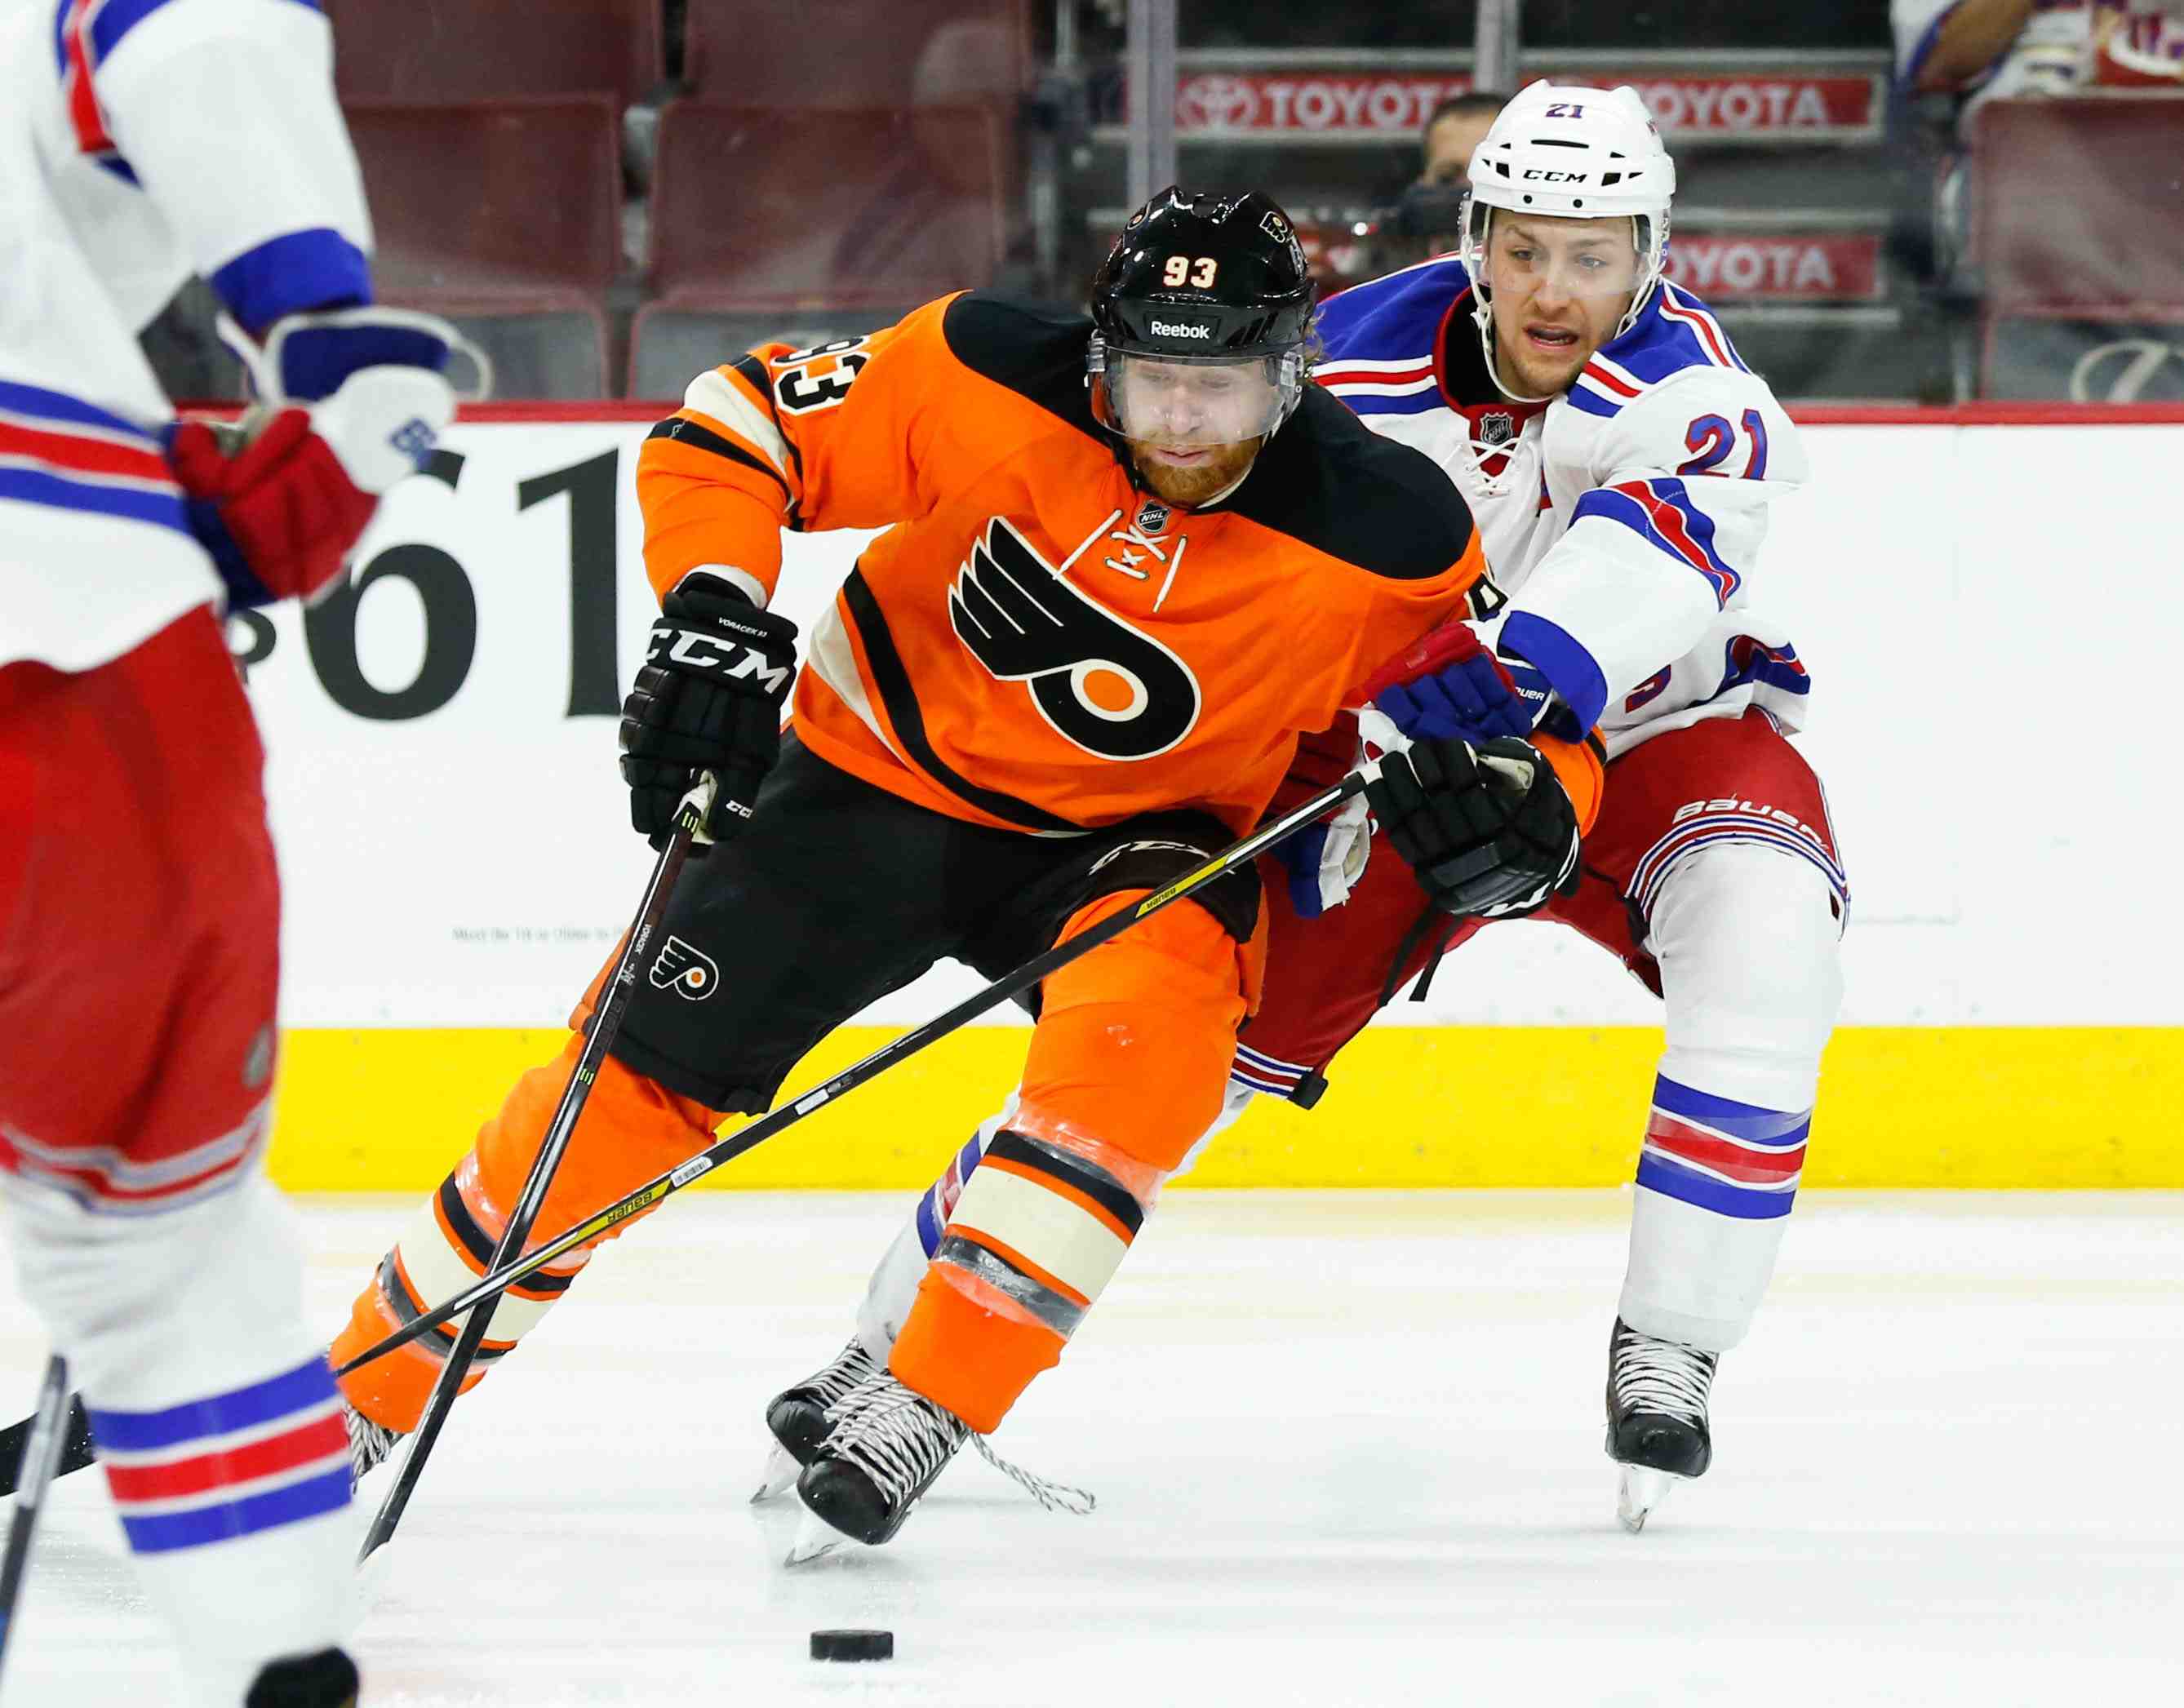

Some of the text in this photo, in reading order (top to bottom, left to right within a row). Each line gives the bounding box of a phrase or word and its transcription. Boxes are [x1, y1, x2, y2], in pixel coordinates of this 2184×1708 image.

[1267, 84, 1464, 129] TOYOT
[1546, 103, 1584, 119] 21
[1637, 84, 1830, 126] OYOTA
[1523, 169, 1587, 183] CCM
[1162, 255, 1218, 289] 93
[1670, 246, 1836, 290] YOTA
[1151, 321, 1210, 339] Reebok
[1676, 408, 1768, 481] 21
[1140, 511, 1164, 523] NHL
[646, 628, 790, 694] CCM
[1515, 686, 1546, 701] UER
[726, 800, 753, 819] CC
